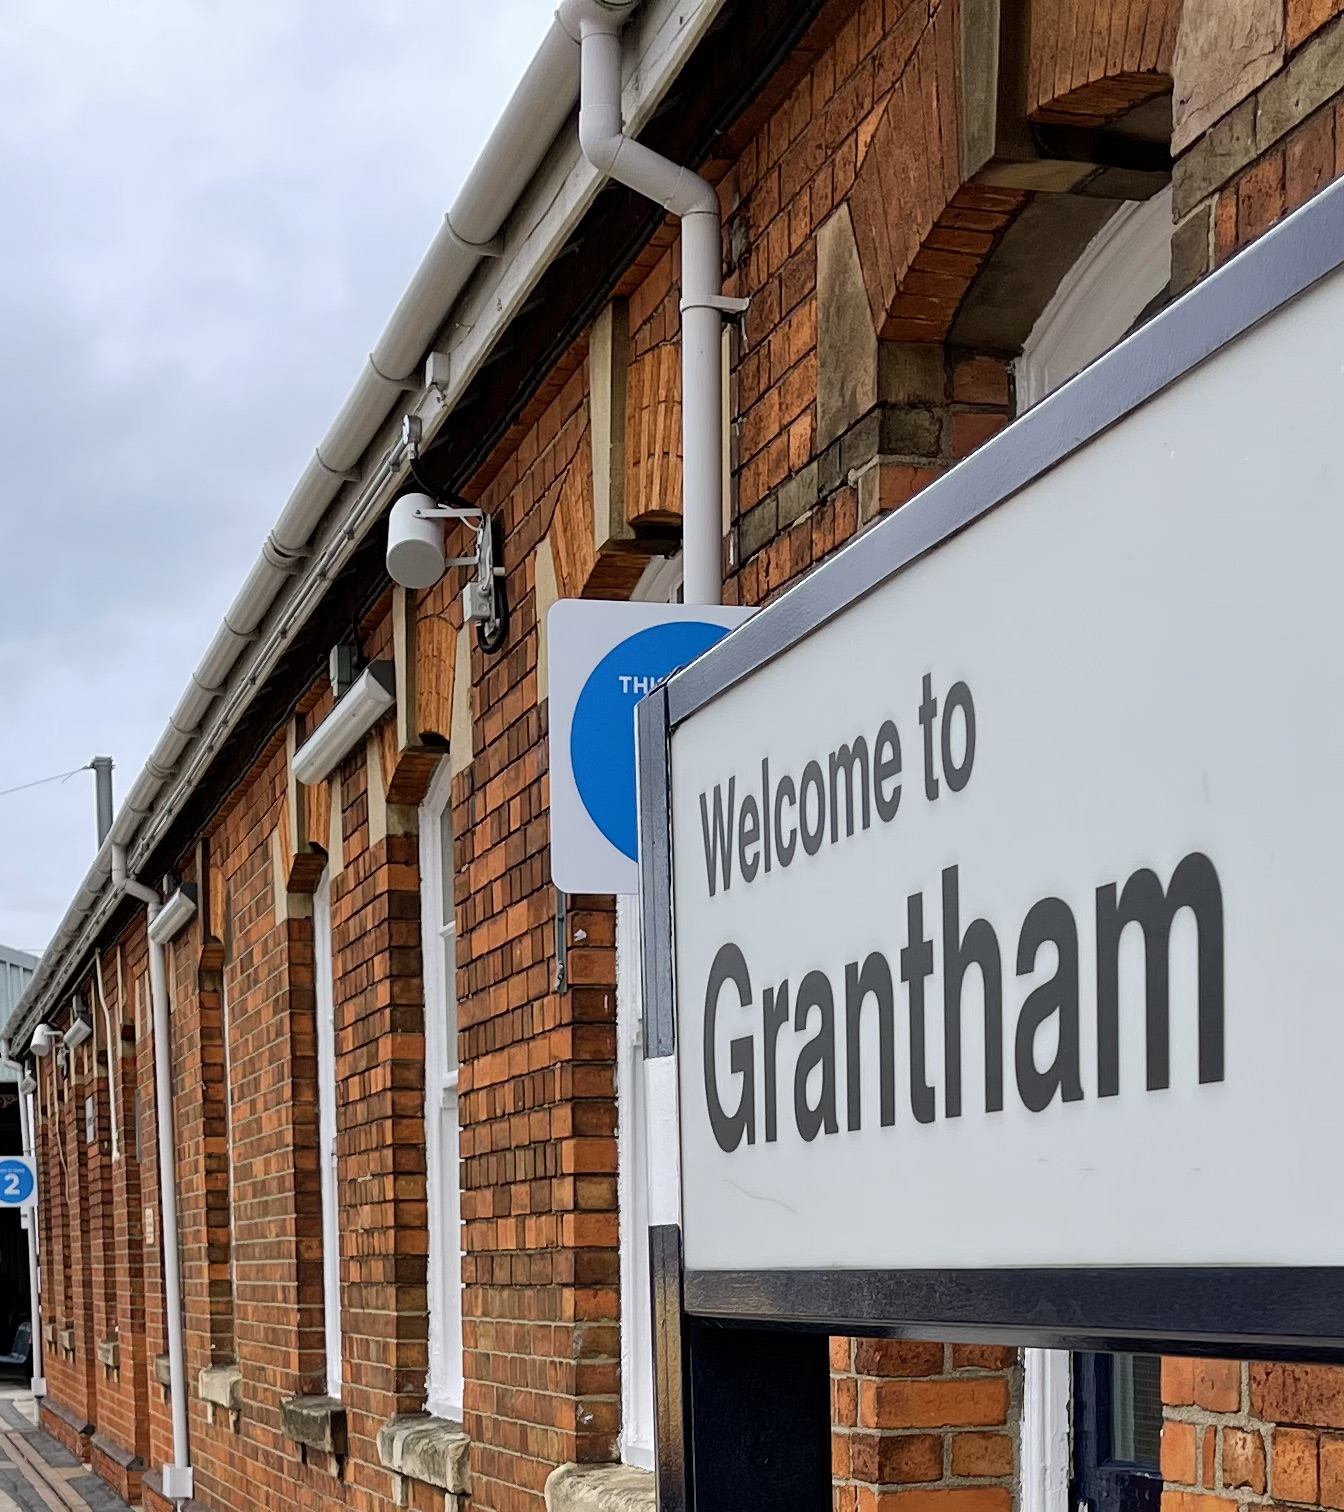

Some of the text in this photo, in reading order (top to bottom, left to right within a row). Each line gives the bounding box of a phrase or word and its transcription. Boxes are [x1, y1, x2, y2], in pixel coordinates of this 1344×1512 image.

[618, 675, 664, 694] THI
[698, 672, 977, 898] Welcome to
[703, 851, 1225, 1154] Grantham
[4, 1173, 21, 1196] 2
